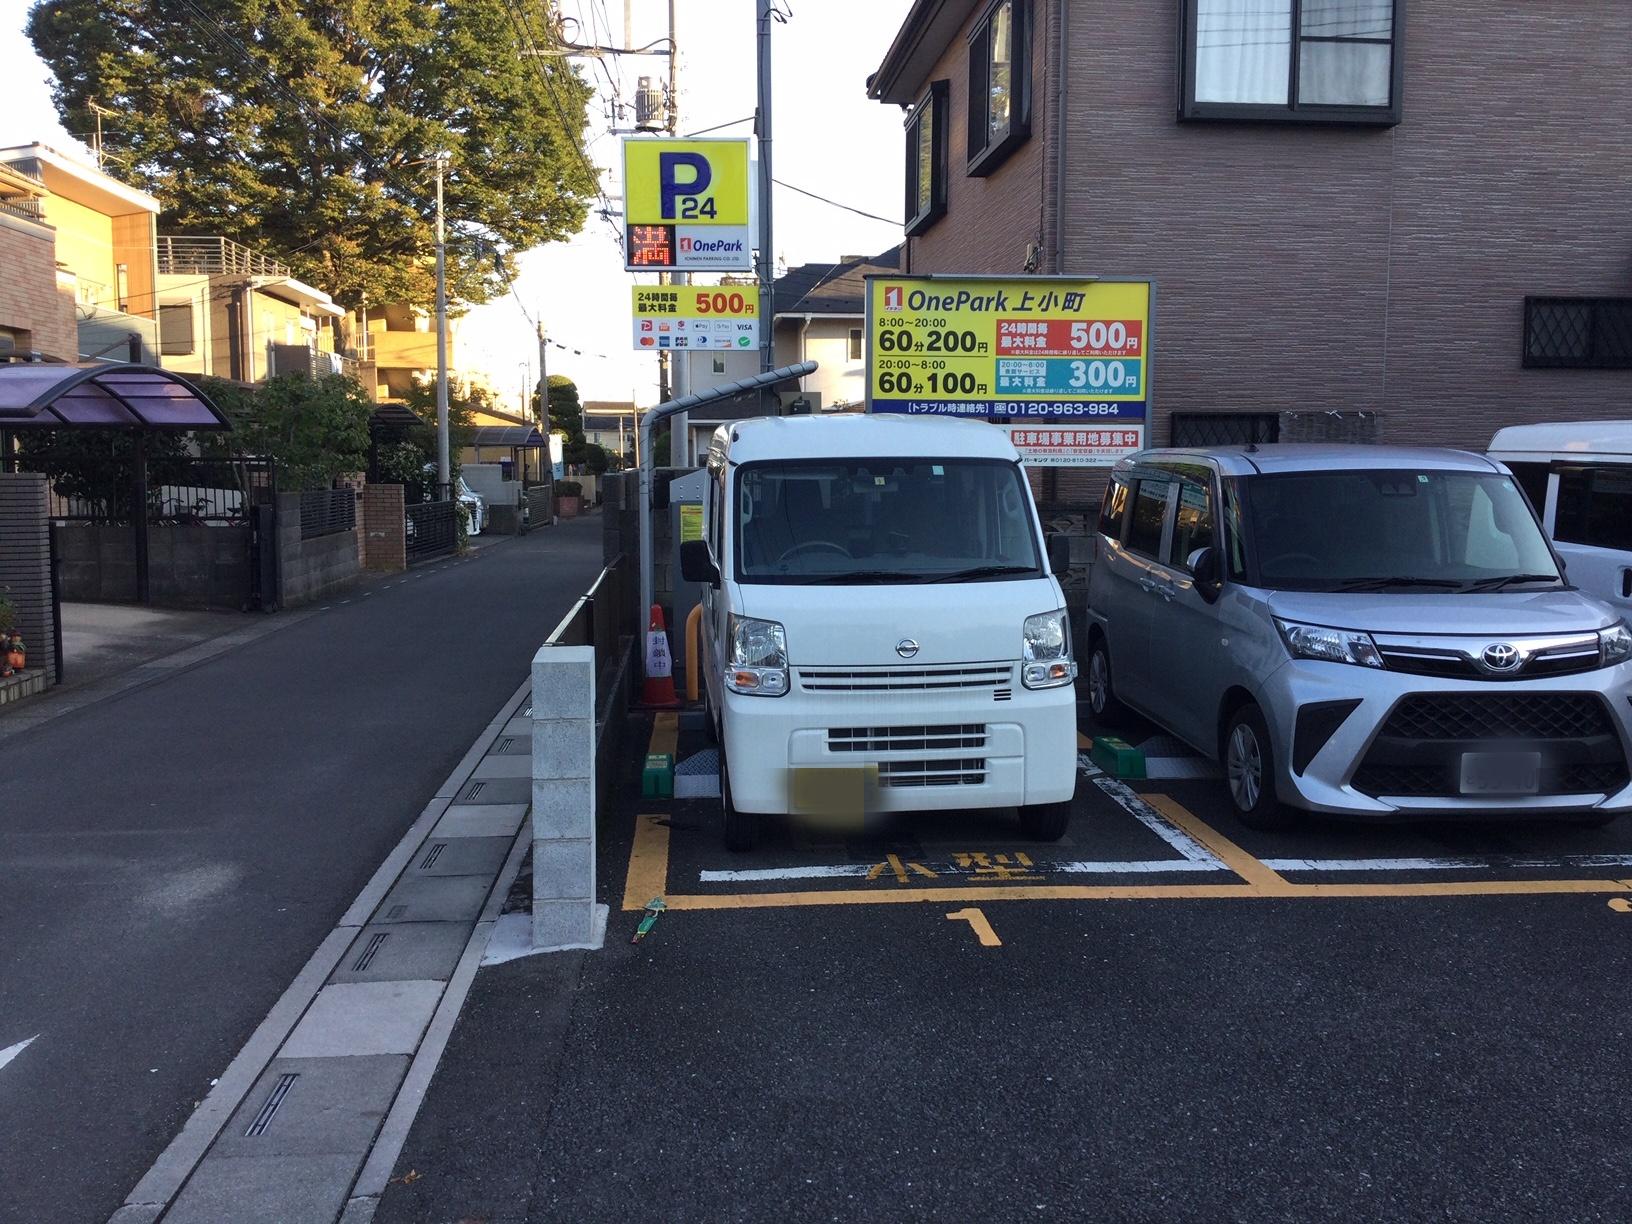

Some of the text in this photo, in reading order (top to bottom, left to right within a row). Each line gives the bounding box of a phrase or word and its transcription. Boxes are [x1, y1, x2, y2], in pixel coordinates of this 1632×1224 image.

[660, 152, 712, 219] P
[681, 197, 717, 219] 24
[693, 239, 743, 252] OnePark
[638, 293, 678, 302] 24時間毎
[638, 303, 677, 312] 最大料金
[696, 293, 755, 314] 500円
[907, 290, 1008, 312] OnePark
[1012, 291, 1086, 312] 上小町
[1000, 322, 1048, 334] 24時間毎
[1070, 322, 1138, 349] 500円
[879, 330, 988, 353] 60分200円
[1000, 336, 1047, 348] 最大料金
[878, 372, 988, 394] 60分100円
[1000, 377, 1046, 387] 最大料金
[1069, 361, 1137, 388] 300円
[1008, 403, 1119, 415] 0120-963-984
[1014, 432, 1136, 446] 駐車場事業用地募集中
[865, 853, 1046, 882] 小型
[946, 908, 1002, 946] 1
